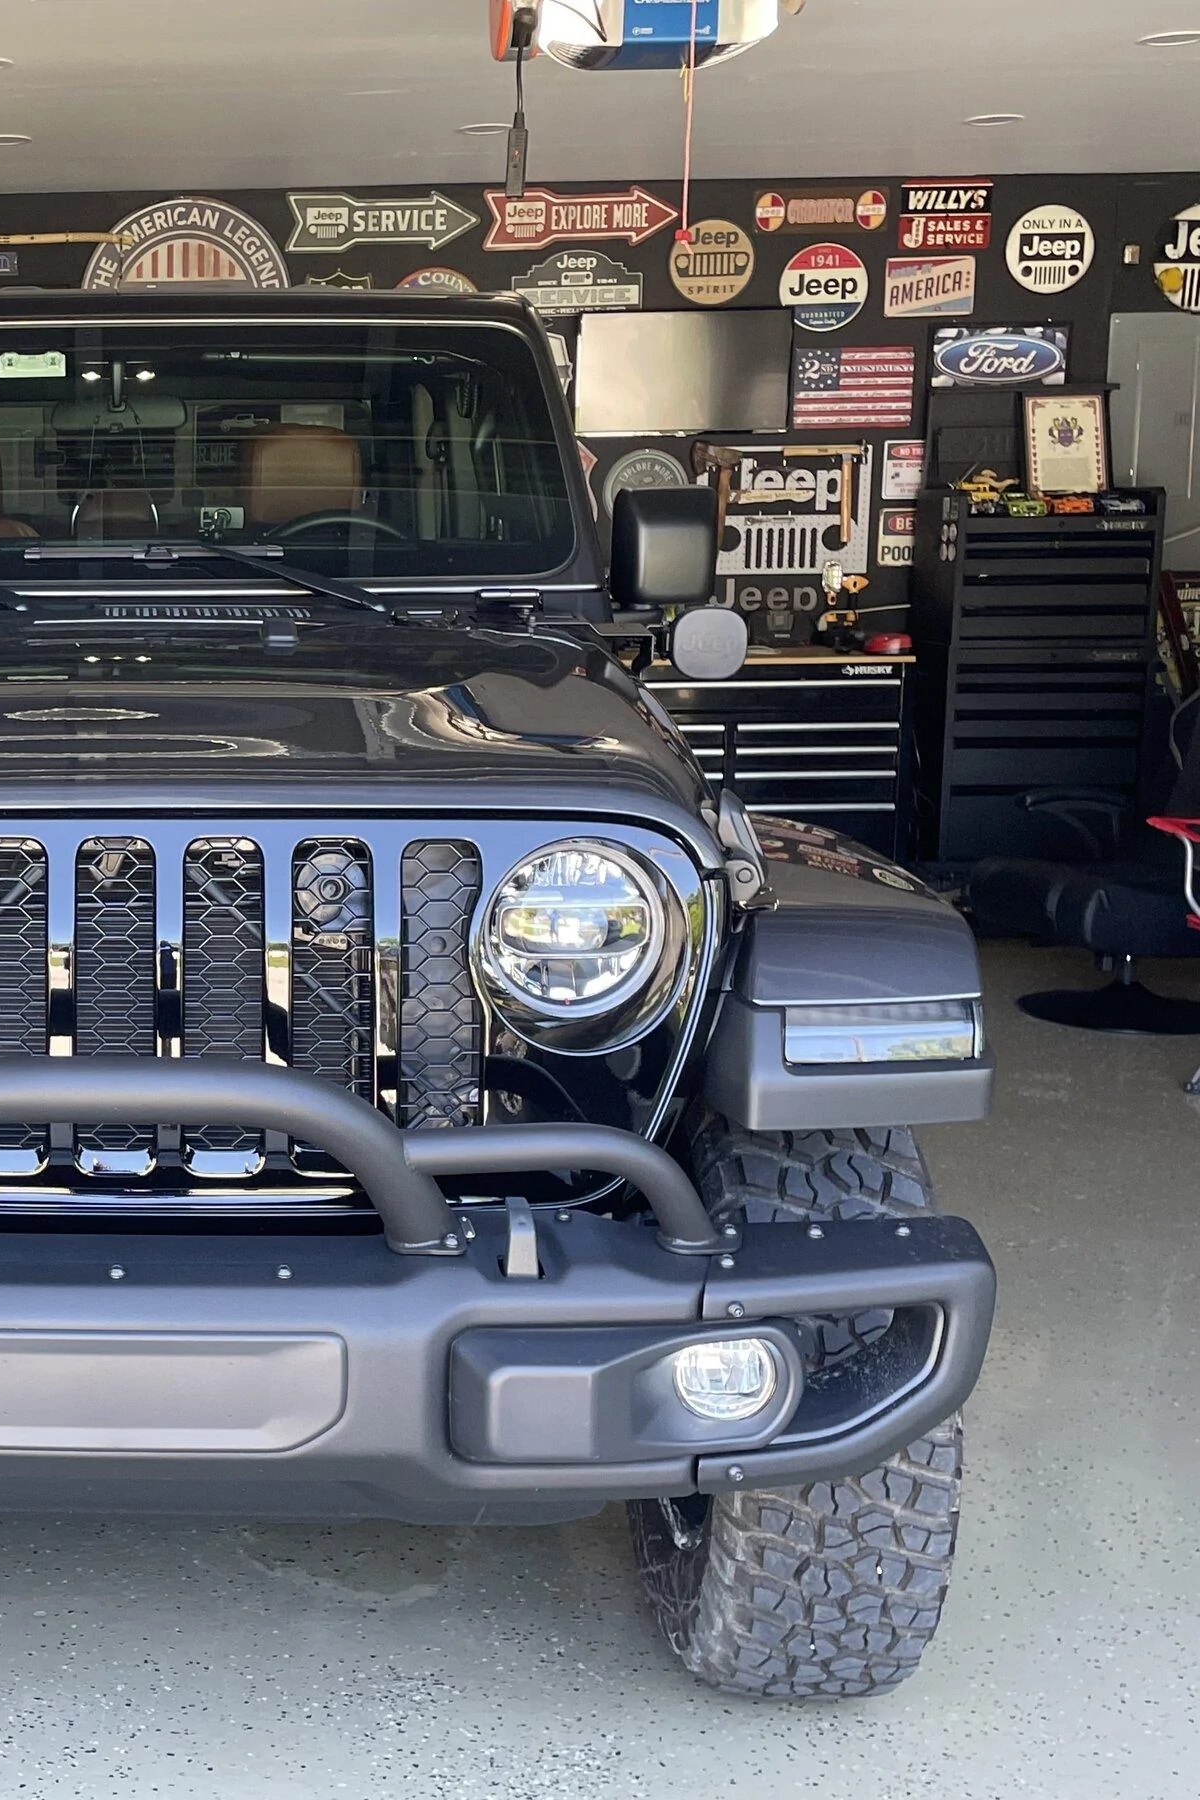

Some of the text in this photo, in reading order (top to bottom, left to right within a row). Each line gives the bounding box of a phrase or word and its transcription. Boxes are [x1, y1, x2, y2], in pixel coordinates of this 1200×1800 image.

[314, 211, 343, 222] Jeep
[507, 205, 544, 219] Jeep
[552, 203, 649, 230] EXPLORE MORE
[353, 208, 447, 232] SERVICE
[927, 220, 984, 232] SALES &
[1022, 218, 1083, 229] ONLY IN A
[689, 228, 740, 248] Jeep
[927, 233, 984, 245] SERVICE
[1023, 235, 1081, 259] Jeep
[556, 255, 597, 270] Jeep
[811, 254, 840, 268] 1941
[688, 284, 736, 295] SPIRIT
[788, 273, 858, 299] Jeep
[890, 270, 962, 307] AMERICA
[960, 342, 1037, 374] Ford
[620, 462, 674, 482] EXPLORE MORE
[854, 666, 893, 674] HUSKY
